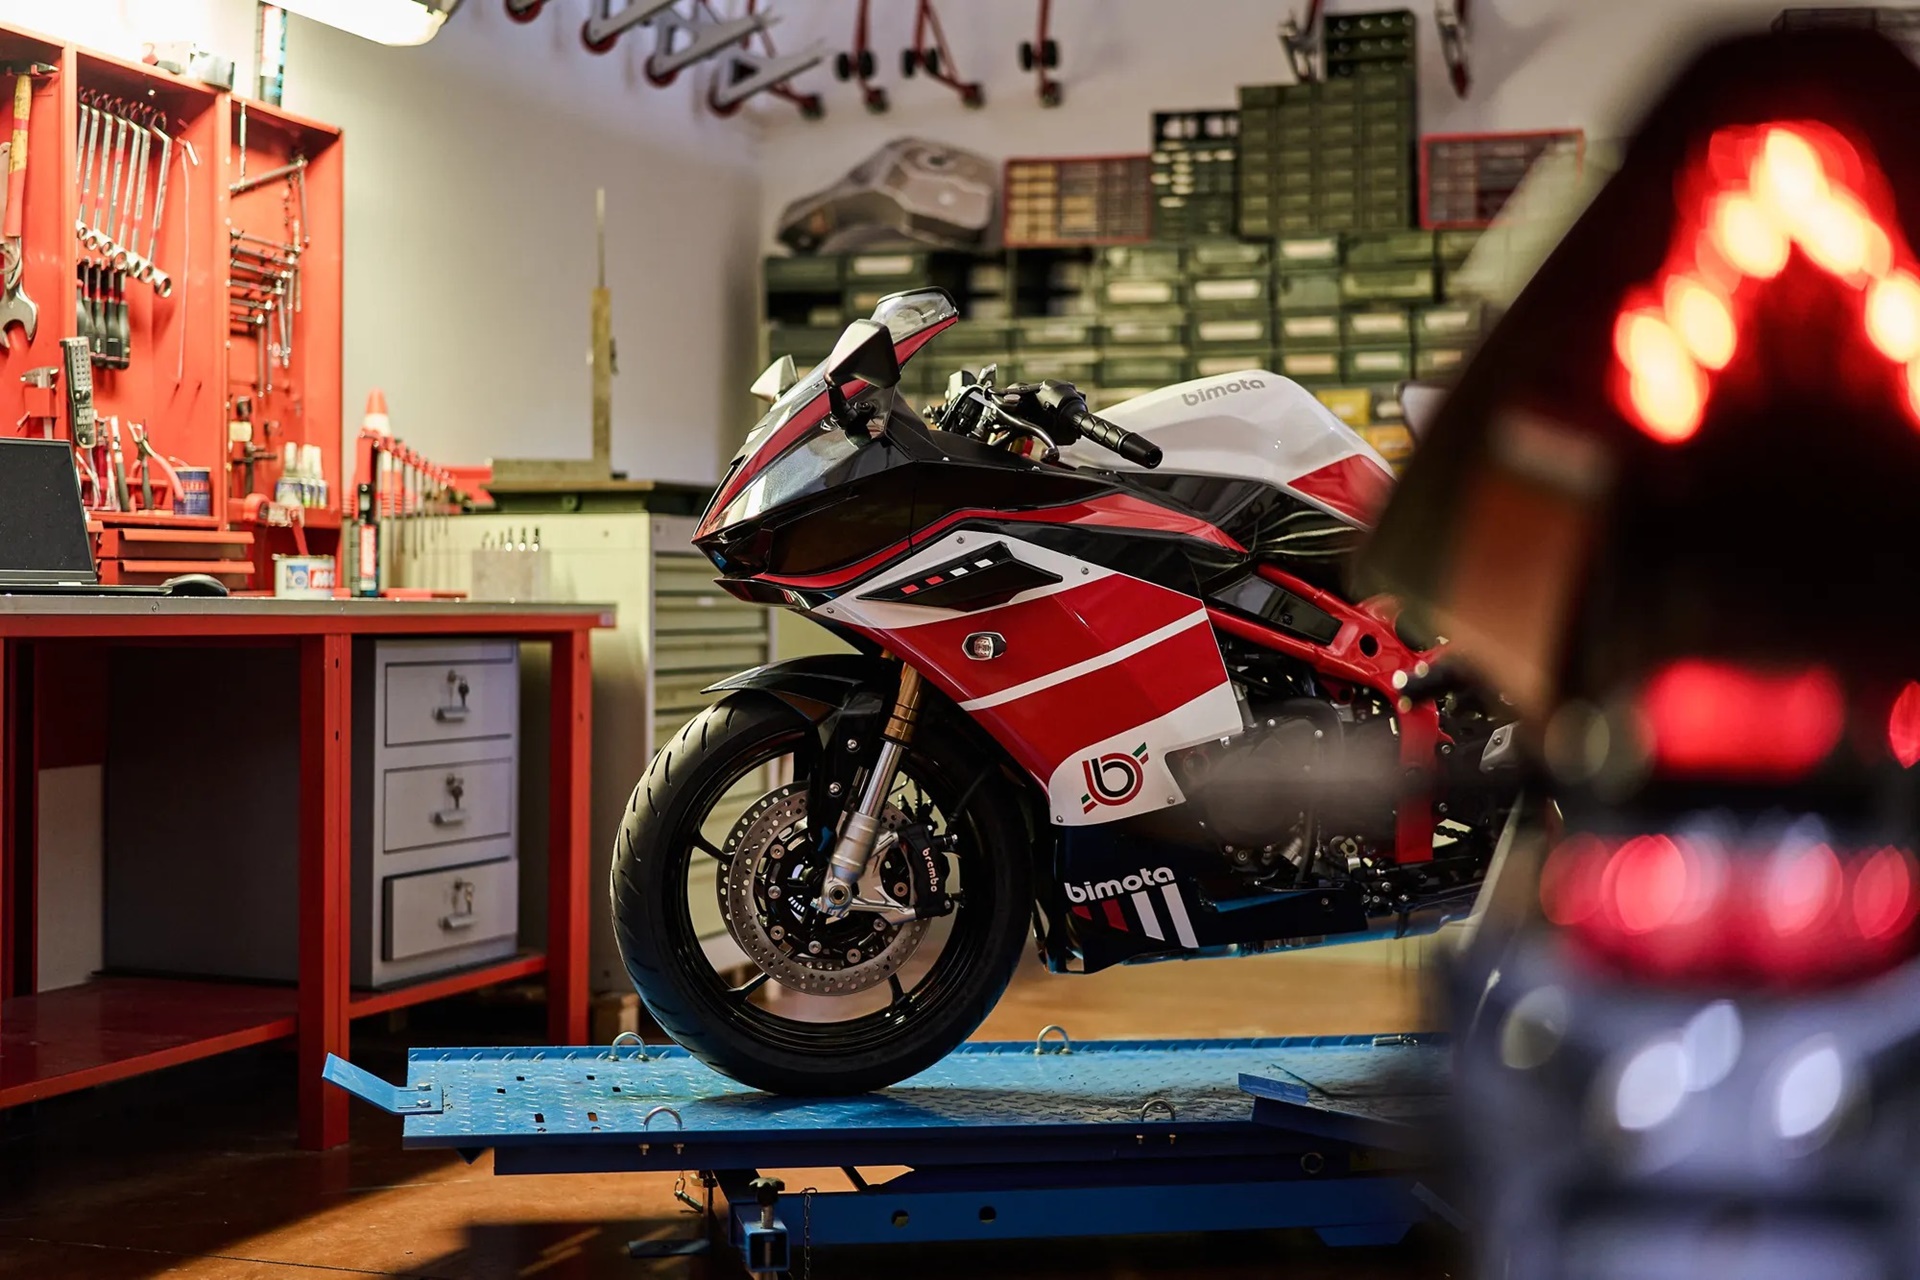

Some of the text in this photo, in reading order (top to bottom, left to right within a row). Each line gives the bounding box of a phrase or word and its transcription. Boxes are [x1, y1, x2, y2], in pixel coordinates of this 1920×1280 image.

[1181, 379, 1266, 406] bimota
[922, 847, 940, 893] brembo
[1064, 866, 1176, 904] bimota
